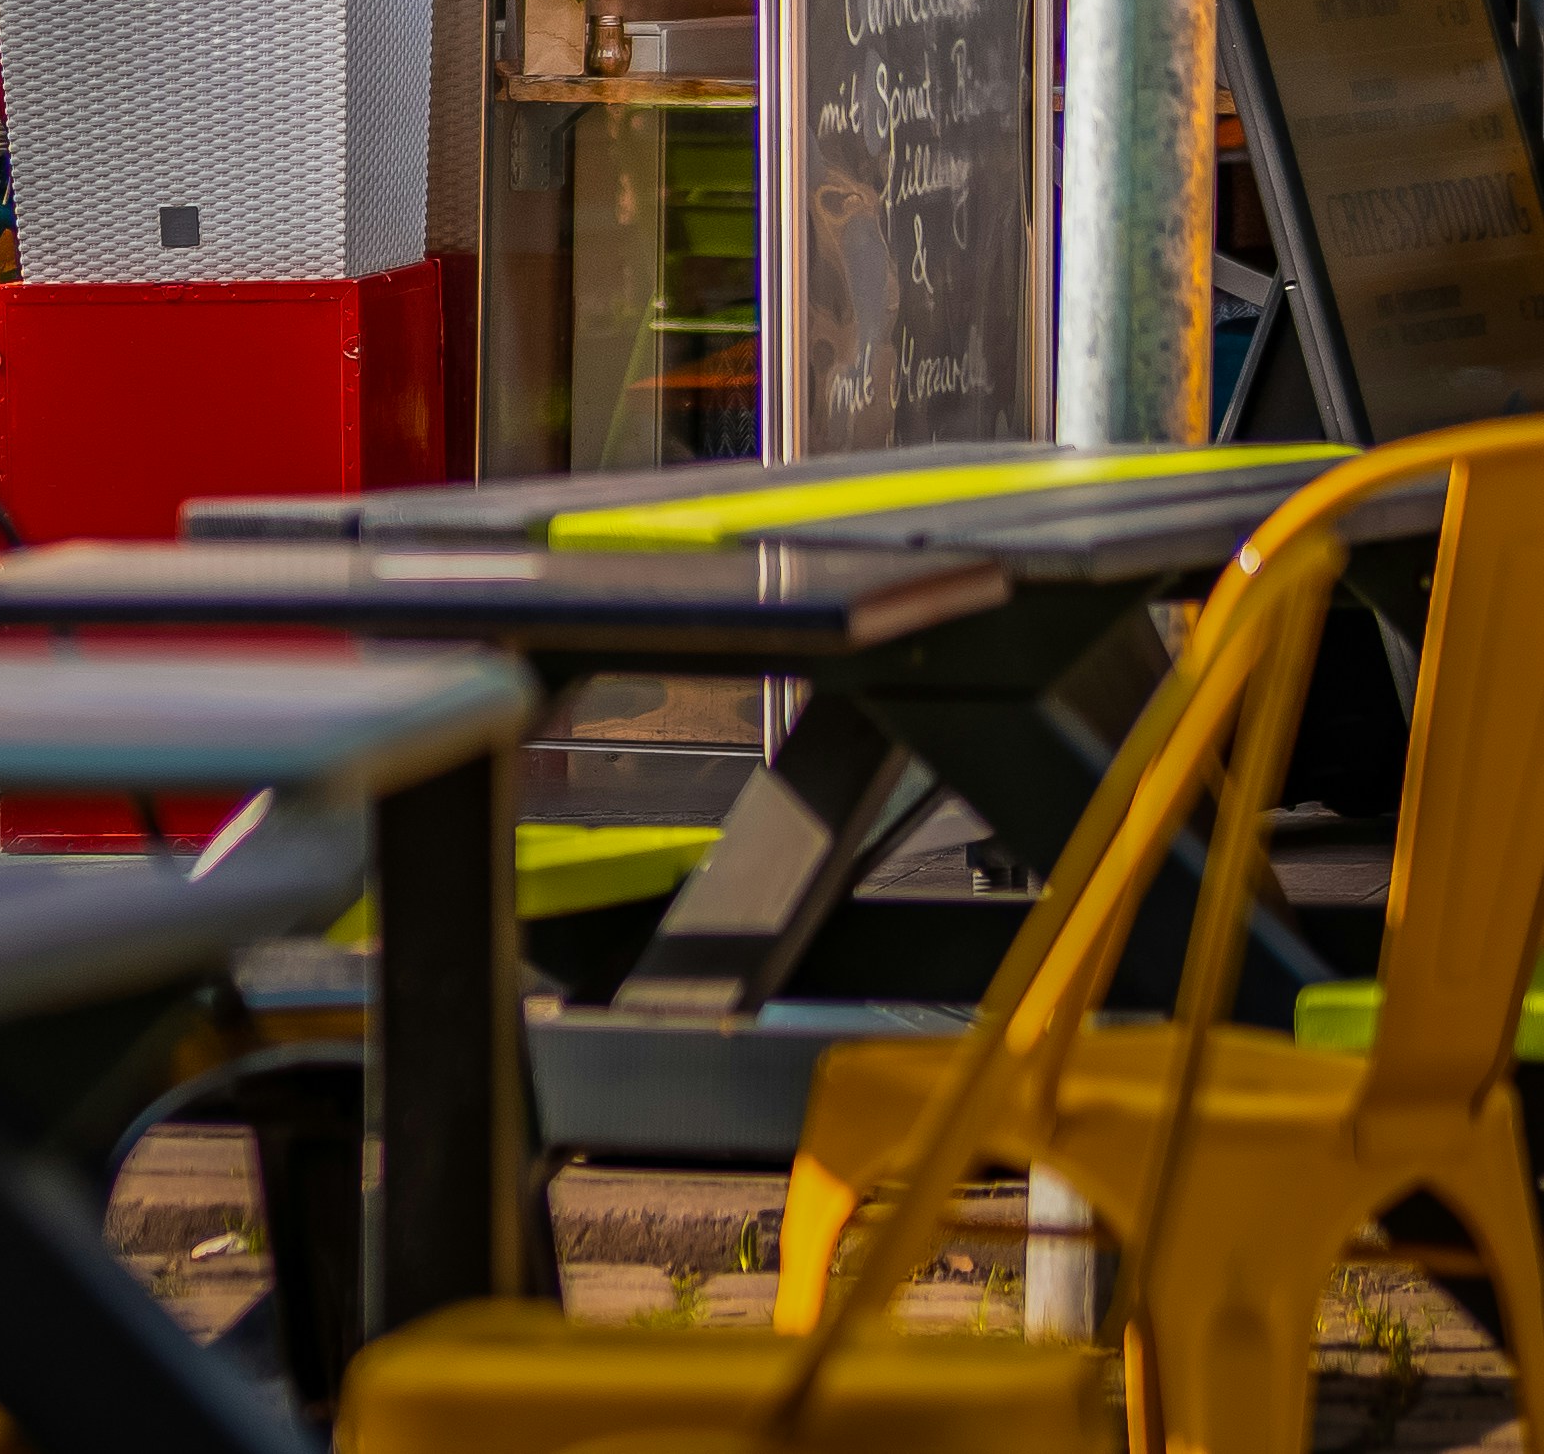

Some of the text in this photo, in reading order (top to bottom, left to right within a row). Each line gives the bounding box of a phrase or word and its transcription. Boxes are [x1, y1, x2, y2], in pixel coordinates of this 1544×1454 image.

[817, 70, 860, 140] mit
[912, 213, 934, 295] &
[827, 341, 874, 419] mit
